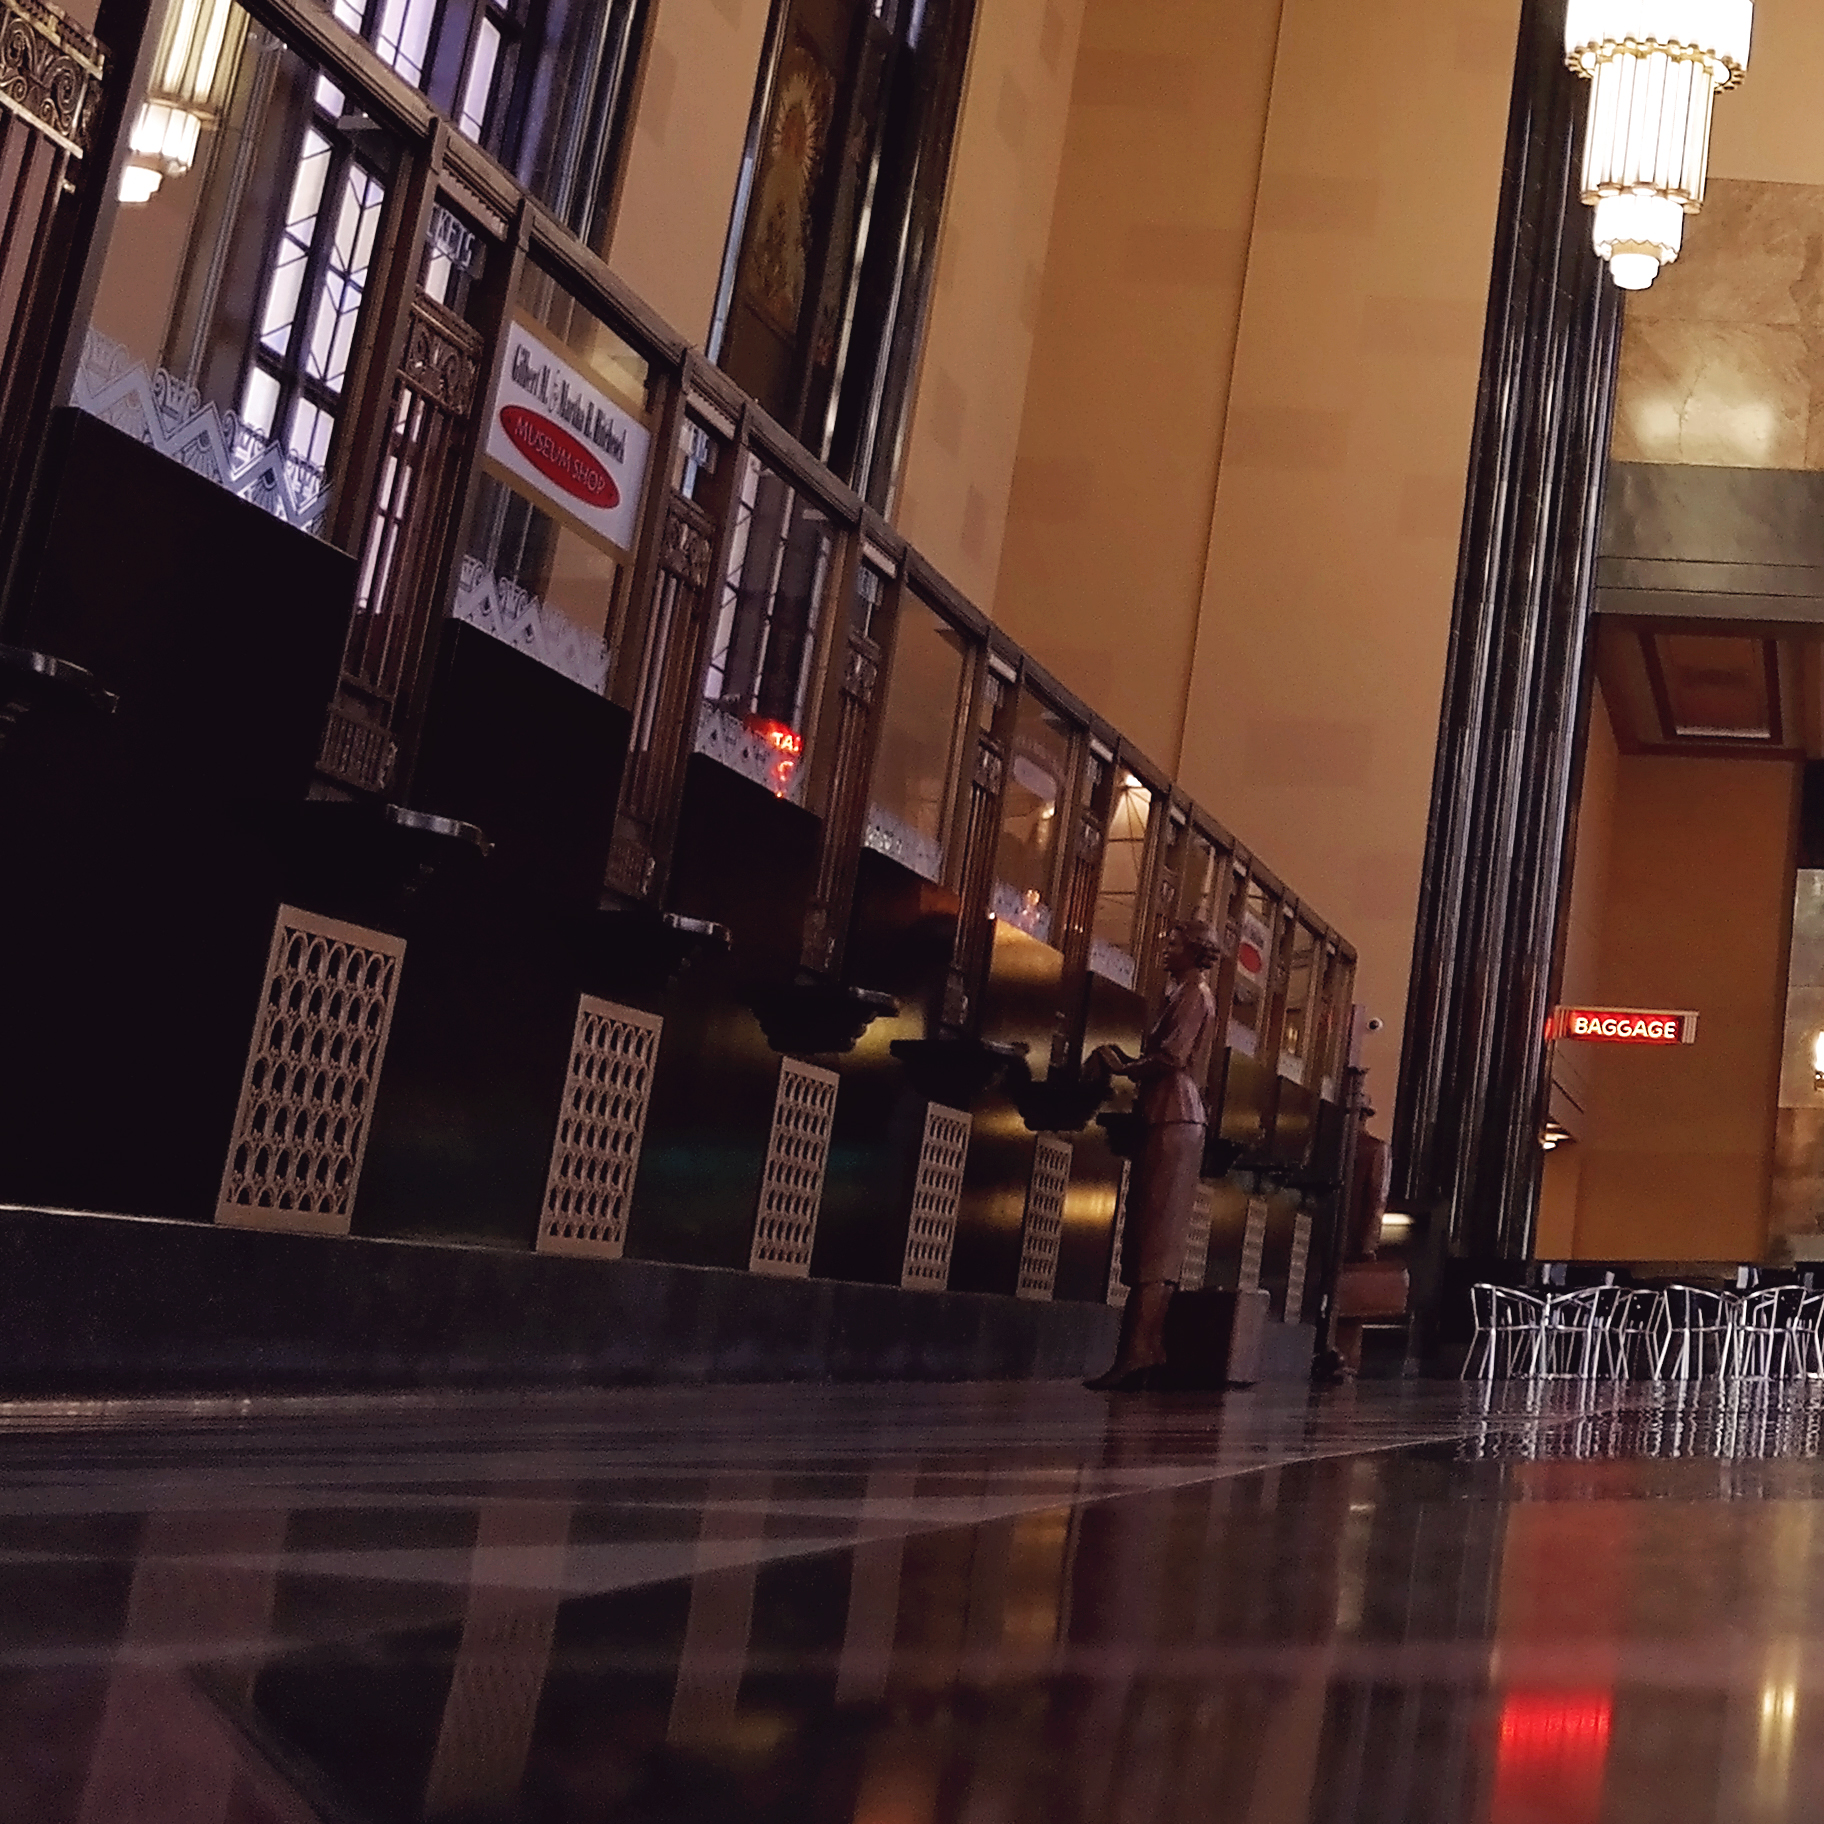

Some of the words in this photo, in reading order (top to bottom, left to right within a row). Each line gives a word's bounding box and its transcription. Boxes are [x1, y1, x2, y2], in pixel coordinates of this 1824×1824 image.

[514, 416, 571, 473] MUSEUM
[572, 458, 605, 494] SHOP
[1574, 1017, 1676, 1039] BAGGAGE
